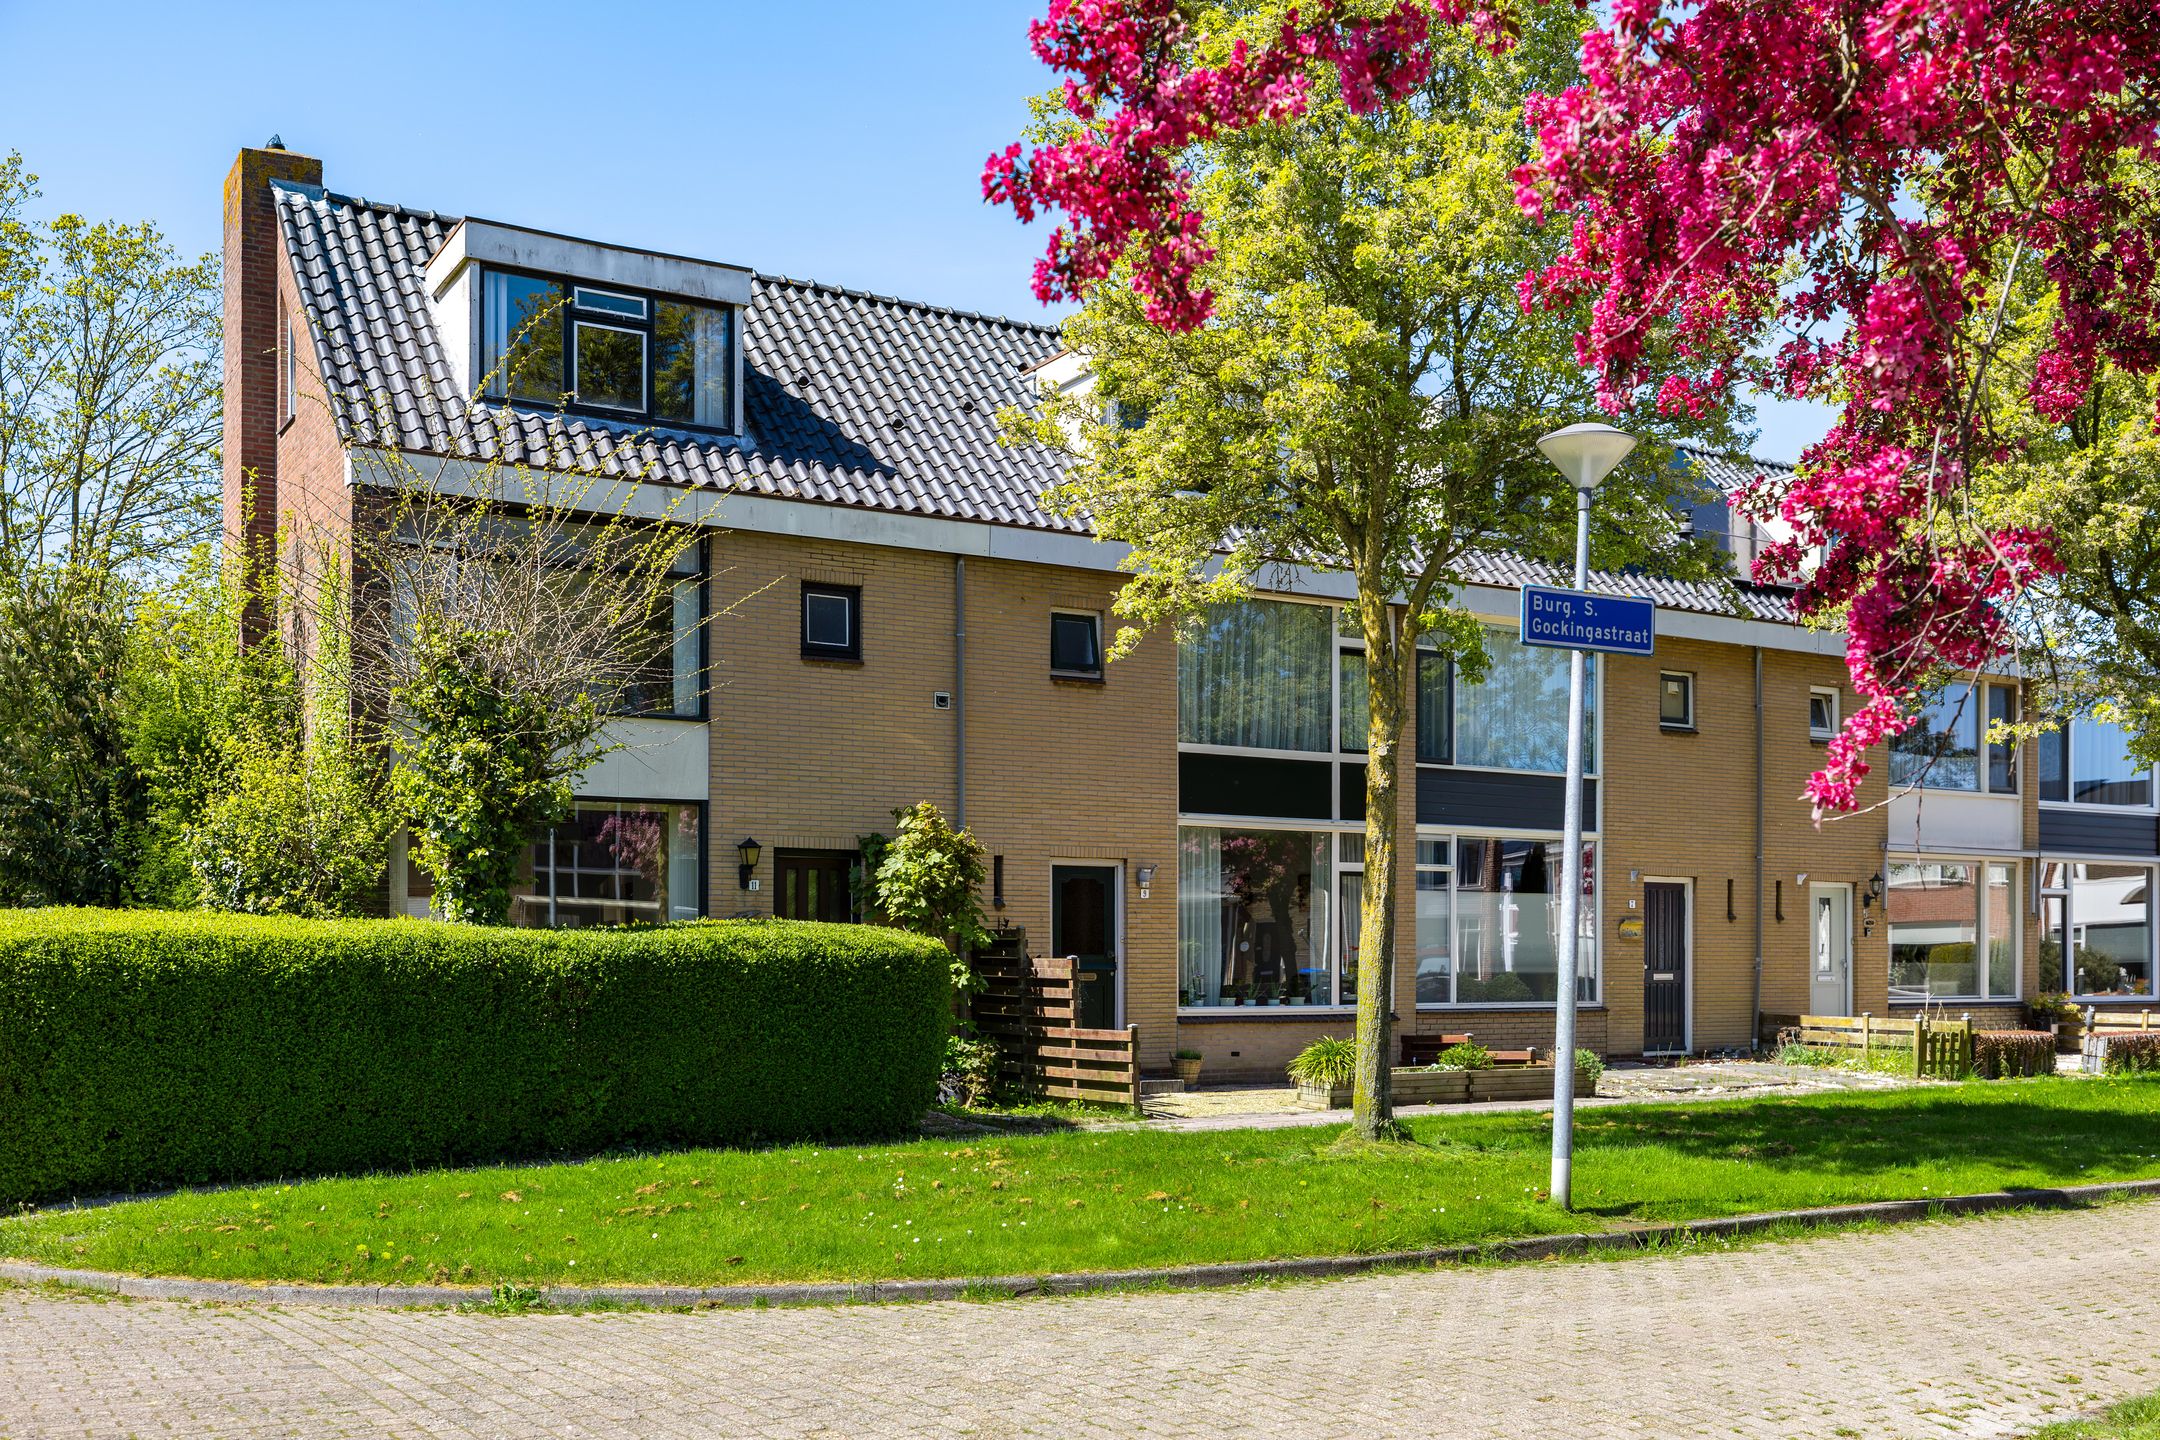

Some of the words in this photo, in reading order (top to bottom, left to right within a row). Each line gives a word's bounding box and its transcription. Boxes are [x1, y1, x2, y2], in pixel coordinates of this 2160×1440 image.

[1533, 595, 1576, 618] Burg.
[1584, 601, 1598, 616] S.
[1532, 617, 1648, 644] Gockingastraat
